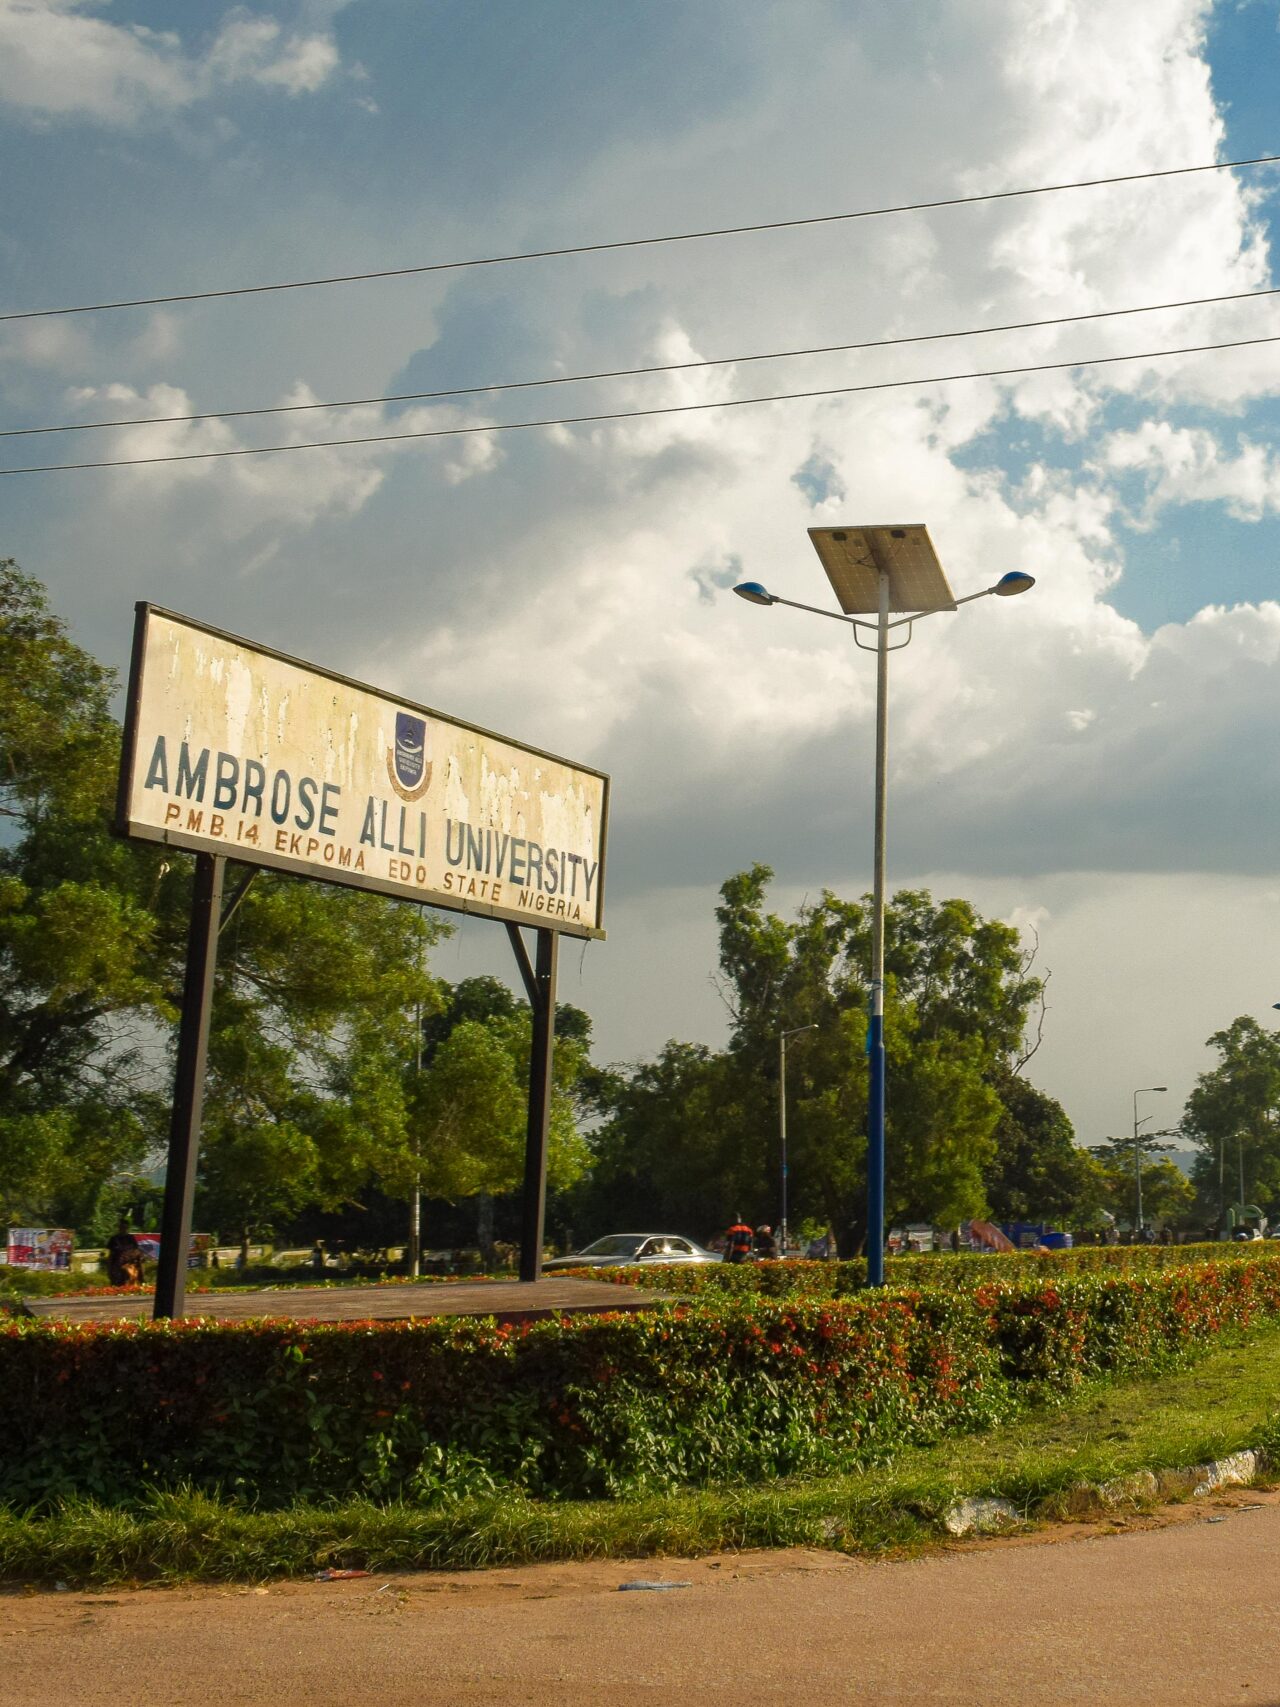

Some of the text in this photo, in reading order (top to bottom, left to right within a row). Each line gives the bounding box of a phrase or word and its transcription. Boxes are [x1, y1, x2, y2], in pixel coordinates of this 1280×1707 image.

[144, 735, 598, 901] AMBROSE ALLI UNIVERSITY
[165, 802, 227, 838] P.M.B.
[275, 829, 365, 871] EKPOMA
[388, 858, 427, 883] EDO
[443, 872, 502, 902] STATE
[518, 889, 581, 920] NIGERIA
